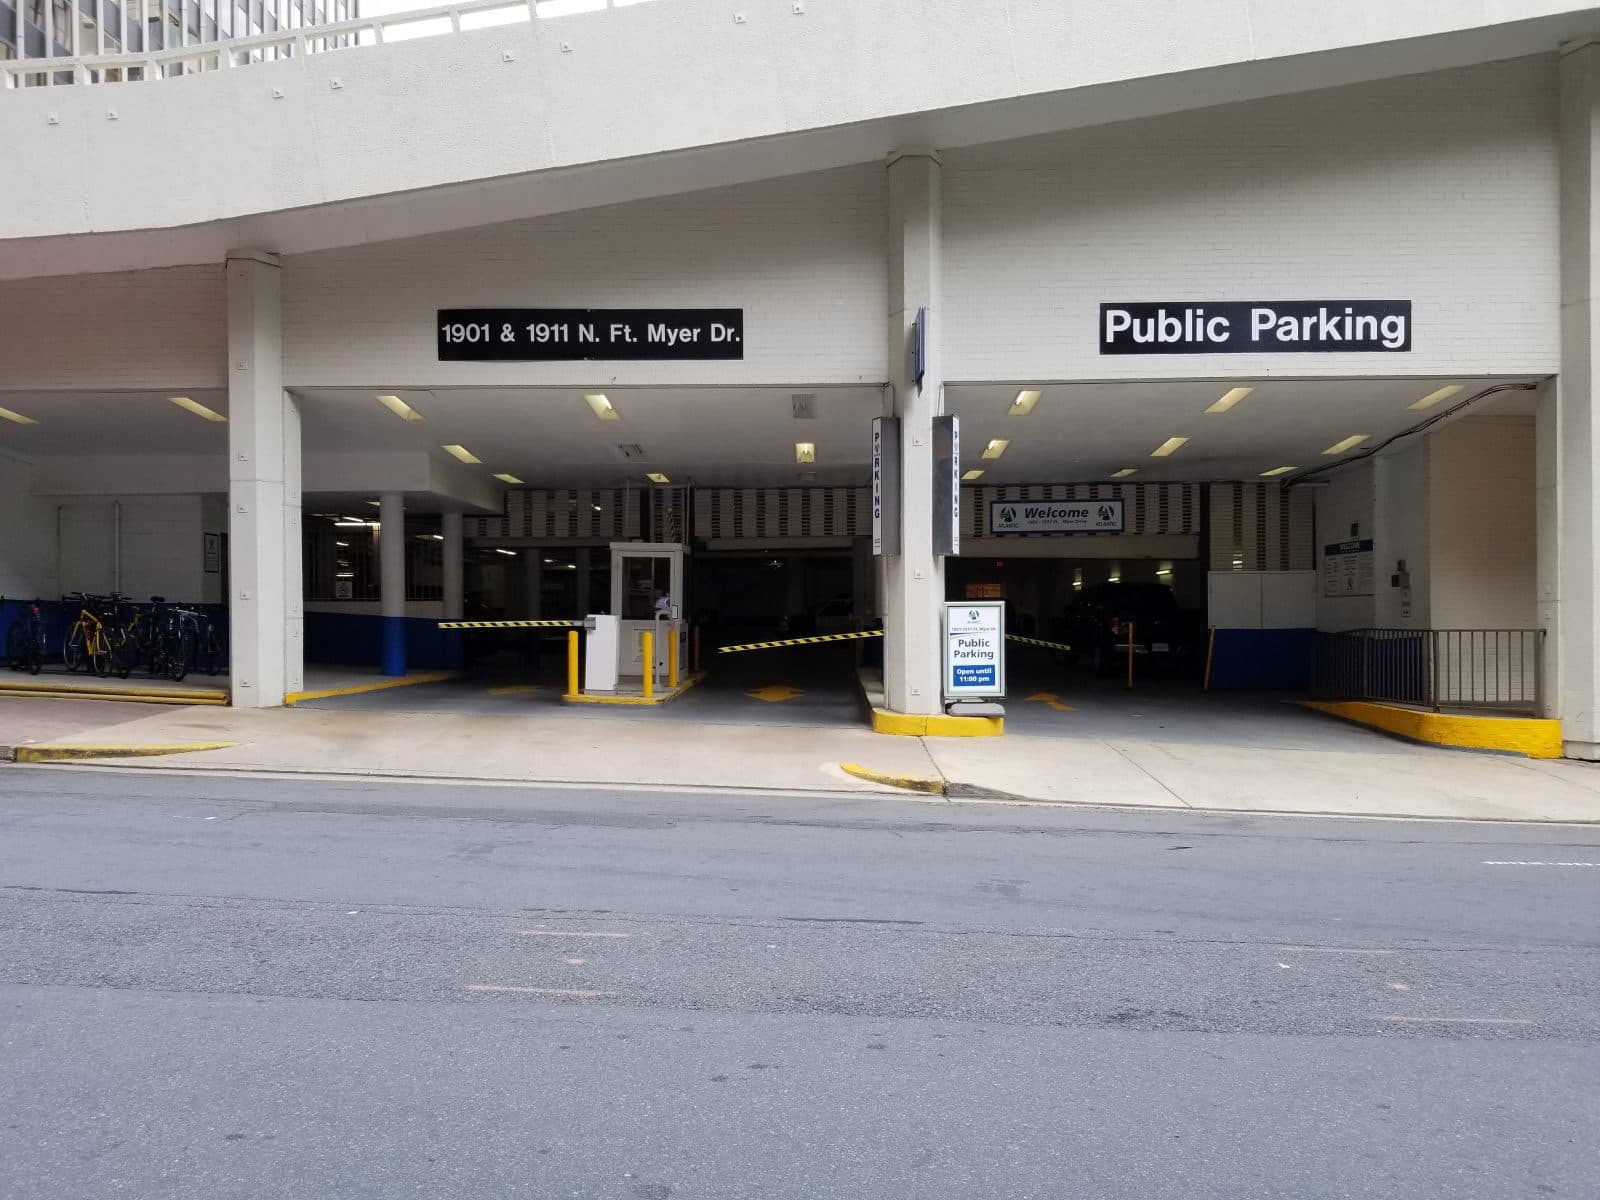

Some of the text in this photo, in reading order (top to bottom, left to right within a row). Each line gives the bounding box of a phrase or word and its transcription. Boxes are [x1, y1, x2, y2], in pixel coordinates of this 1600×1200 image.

[1105, 308, 1406, 348] Public Parking
[442, 323, 741, 346] 1901 & 1911 N. Ft. Myer Dr.
[1024, 506, 1089, 519] Welcome
[958, 638, 990, 647] Public
[954, 649, 994, 660] Parking
[956, 668, 974, 676] Open
